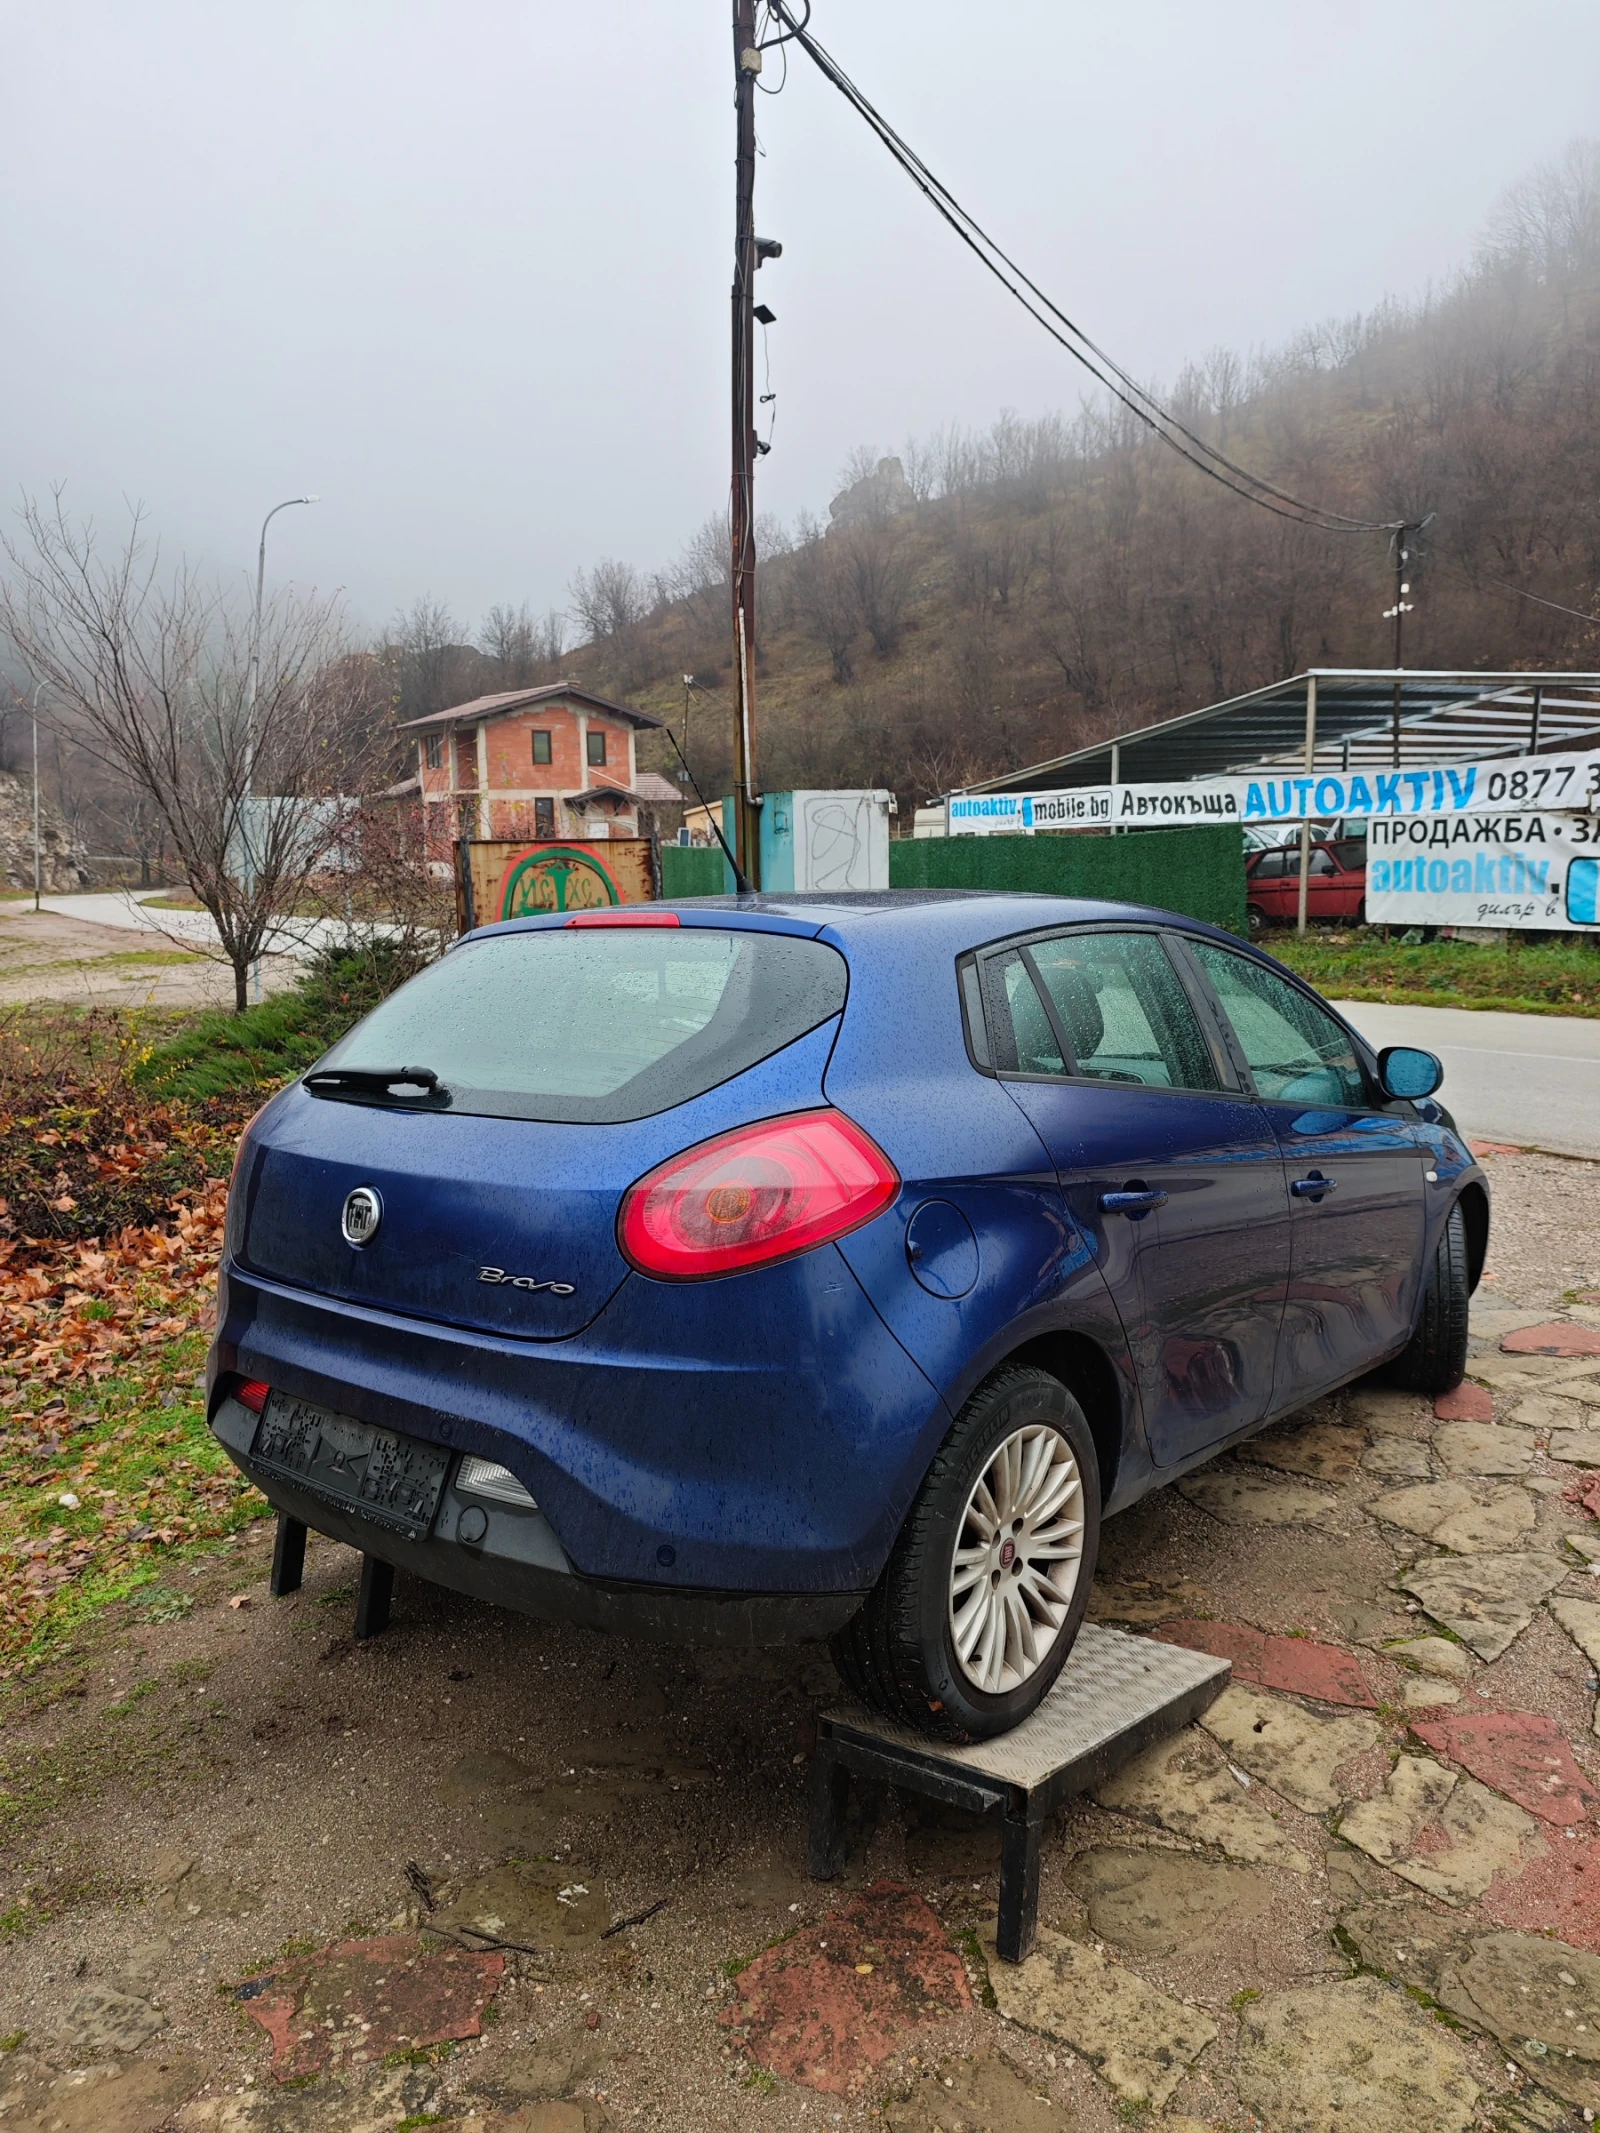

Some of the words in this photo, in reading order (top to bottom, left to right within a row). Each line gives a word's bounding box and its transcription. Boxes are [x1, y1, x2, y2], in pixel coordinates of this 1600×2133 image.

[1120, 790, 1236, 818] Автокъща
[1241, 767, 1477, 818] AUTOAKTIV
[1487, 766, 1576, 802] 0877
[1033, 796, 1109, 821] mobile.bg
[1373, 817, 1546, 849] ПРОДАЖБА
[476, 1266, 575, 1295] Bravo
[1003, 1545, 1013, 1563] FIAT
